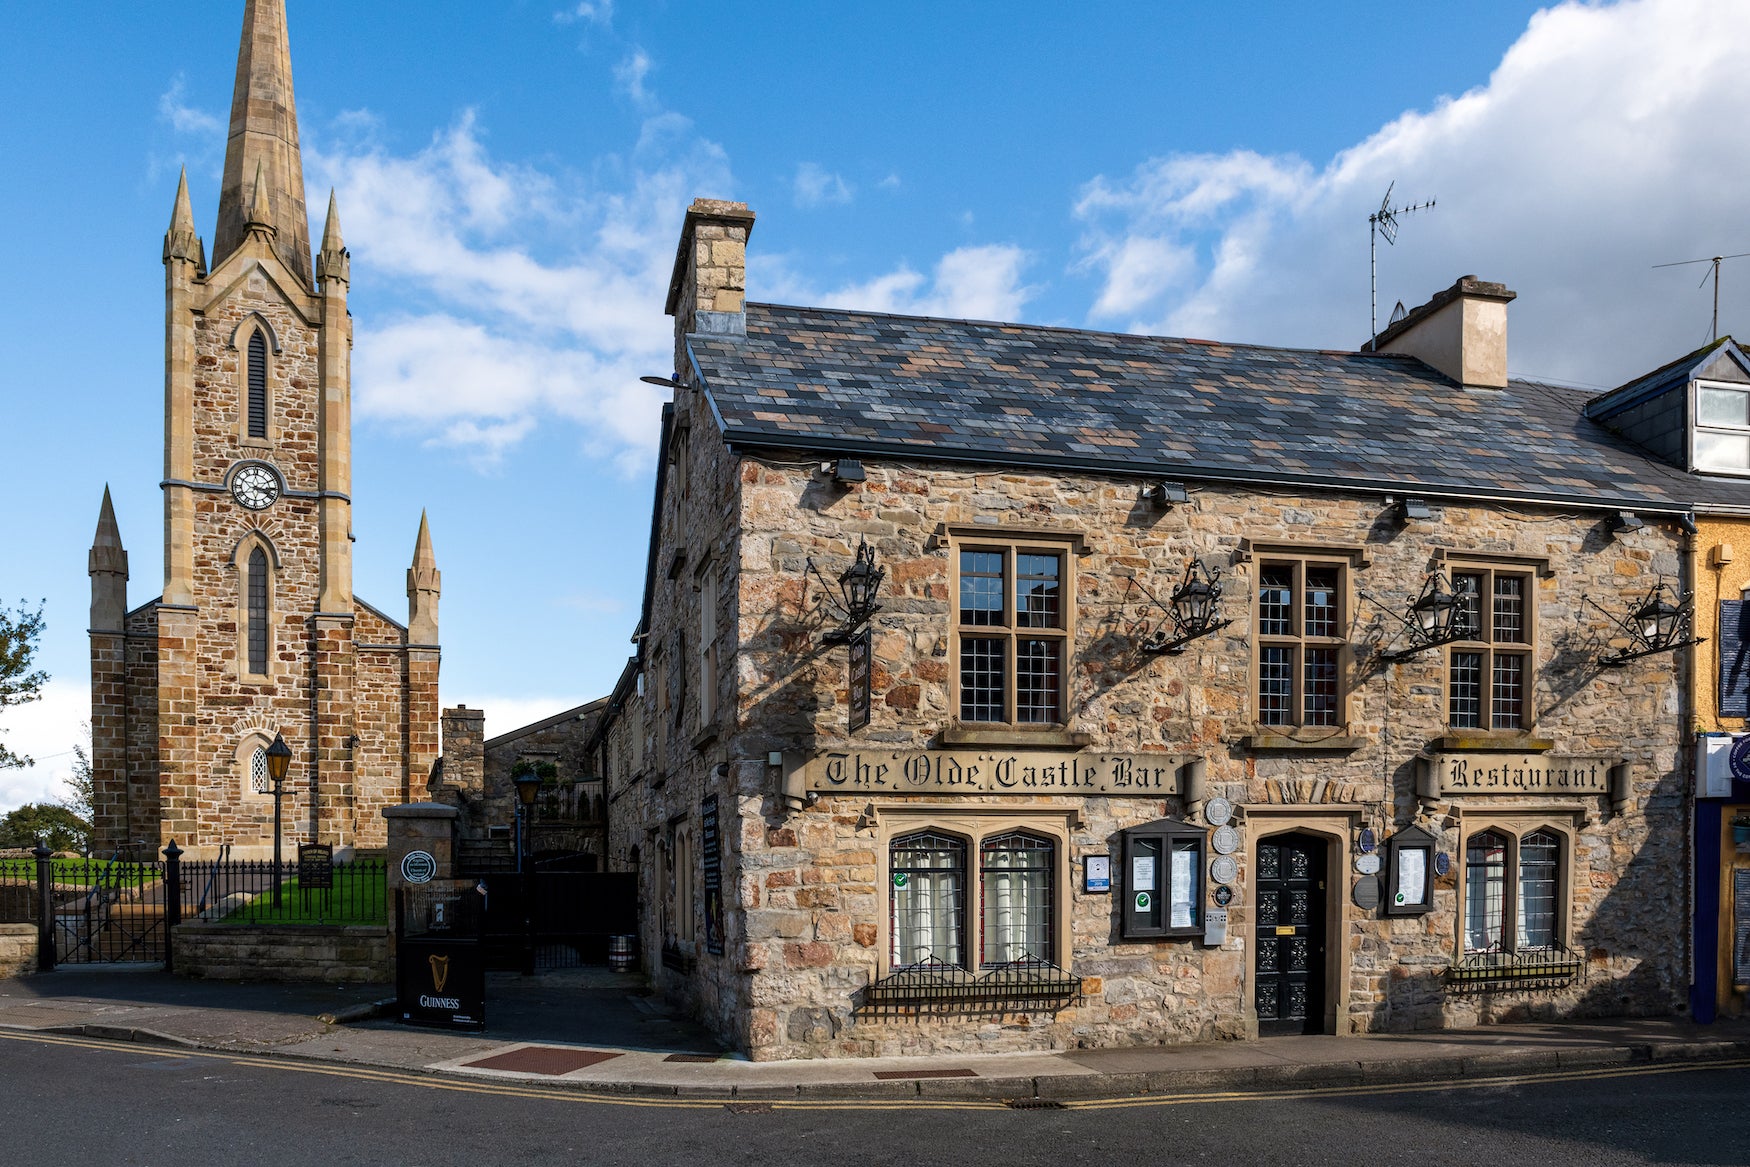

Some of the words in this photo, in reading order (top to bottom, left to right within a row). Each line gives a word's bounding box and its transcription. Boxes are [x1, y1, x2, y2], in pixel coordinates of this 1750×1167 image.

[1732, 742, 1743, 758] COFFEE
[826, 753, 889, 789] The
[904, 754, 979, 786] Olde
[995, 756, 1097, 788] Castle
[1111, 757, 1165, 788] Bar
[1450, 759, 1597, 788] Restaurant
[420, 995, 460, 1009] GUINNESS
